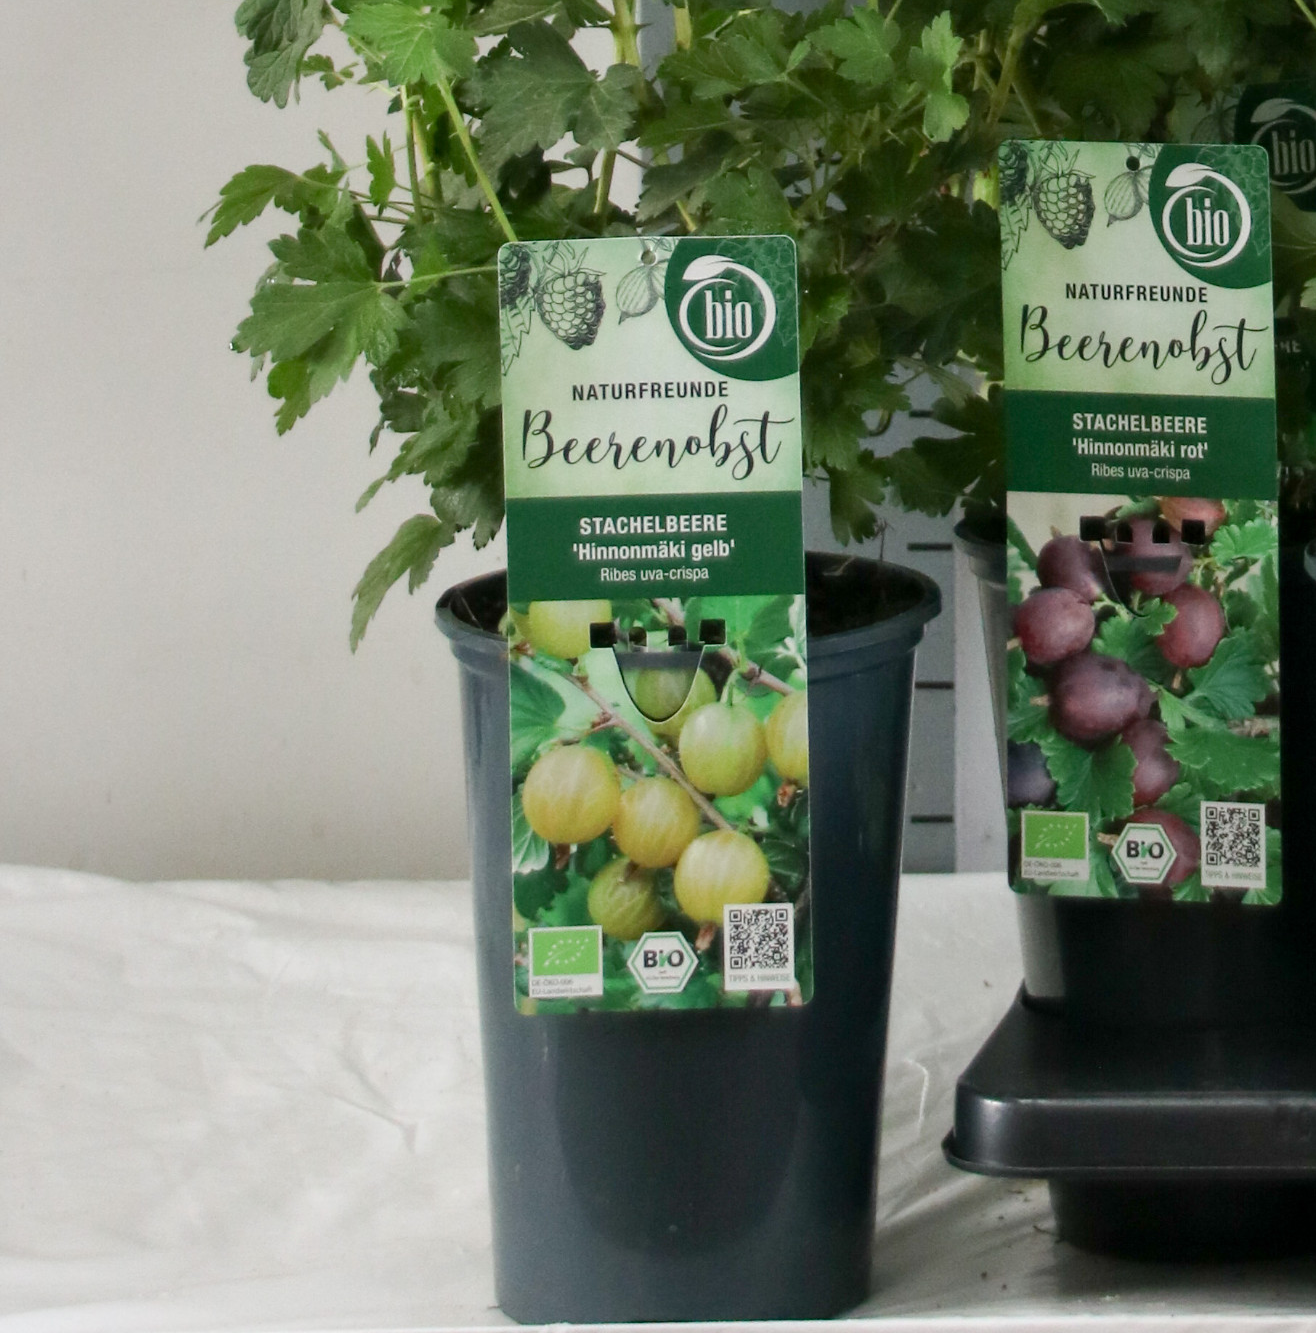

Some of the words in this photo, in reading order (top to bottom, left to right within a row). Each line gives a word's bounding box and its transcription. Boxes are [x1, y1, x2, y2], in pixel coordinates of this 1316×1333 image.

[1272, 130, 1316, 175] bio
[1185, 197, 1230, 247] bio
[1065, 283, 1209, 304] NATURFREUNDE
[704, 289, 753, 340] bio
[1020, 304, 1269, 385] Beerenobst
[572, 380, 729, 402] NATURFREUNDE
[1072, 413, 1208, 435] STACHELBEERE
[522, 403, 795, 481] Beerenobst
[1072, 438, 1176, 458] 'Hinnonmäki
[1180, 442, 1208, 460] rot'
[1091, 463, 1125, 478] Ribes
[1127, 464, 1191, 481] uva-crispa
[579, 514, 728, 536] STACHELBEERE
[572, 540, 686, 562] 'Hinnonmäki
[690, 538, 735, 562] gelb'
[600, 566, 637, 582] Ribes
[640, 565, 709, 583] uva-crispa
